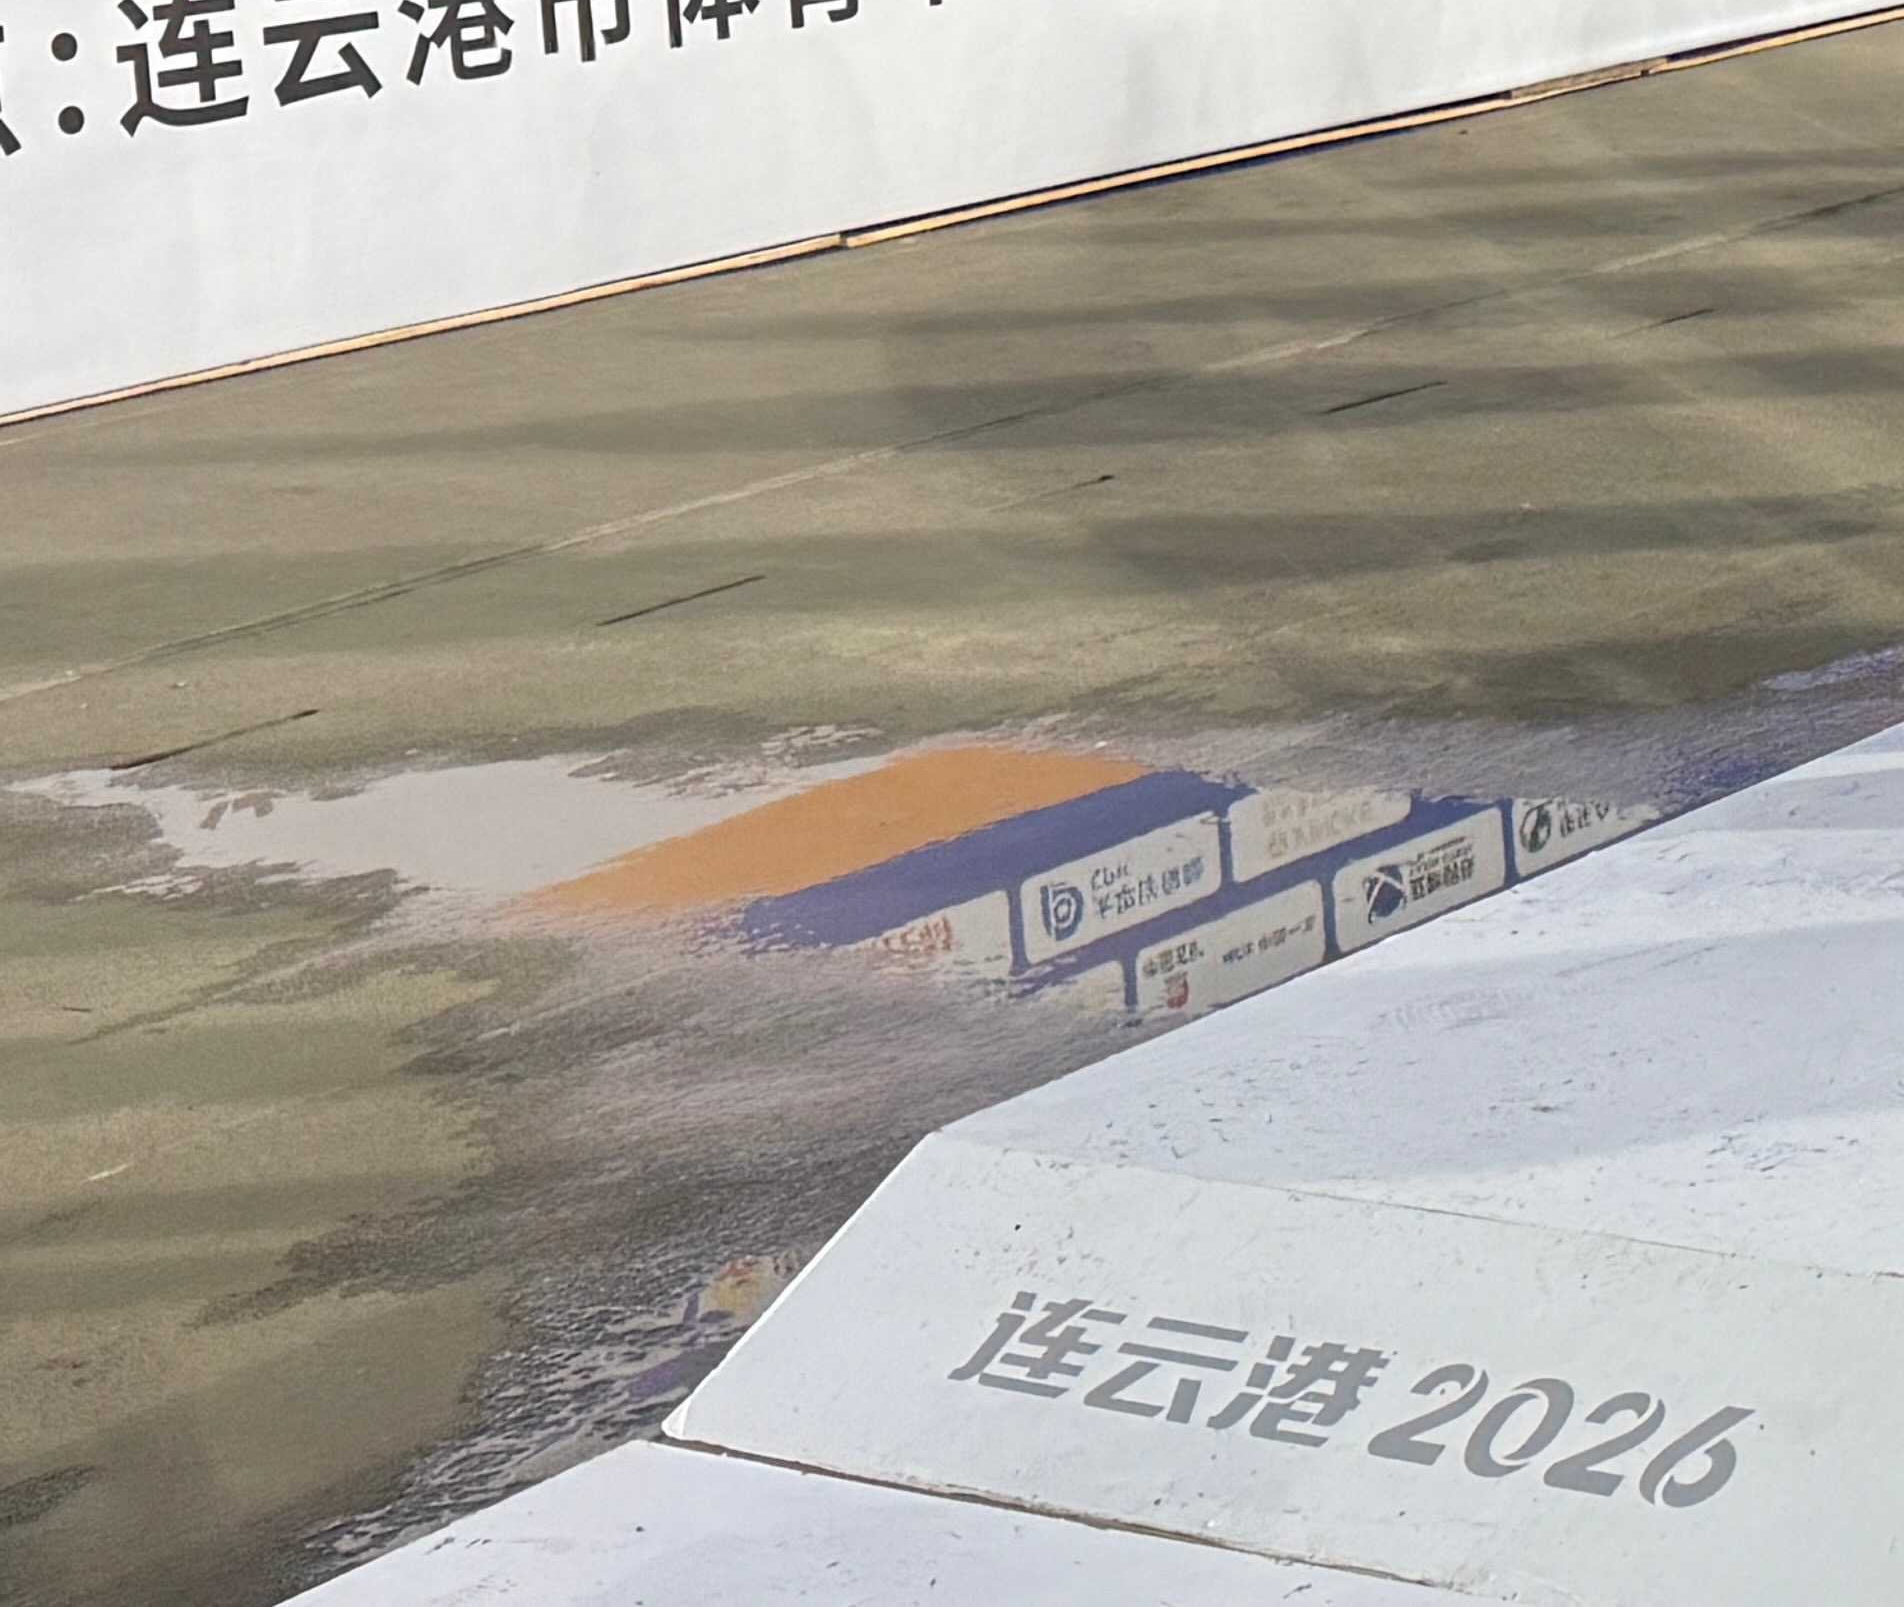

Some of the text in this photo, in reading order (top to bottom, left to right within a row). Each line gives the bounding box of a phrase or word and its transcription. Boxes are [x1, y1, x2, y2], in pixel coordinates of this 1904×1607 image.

[948, 1290, 1756, 1509] 连云港 2026
